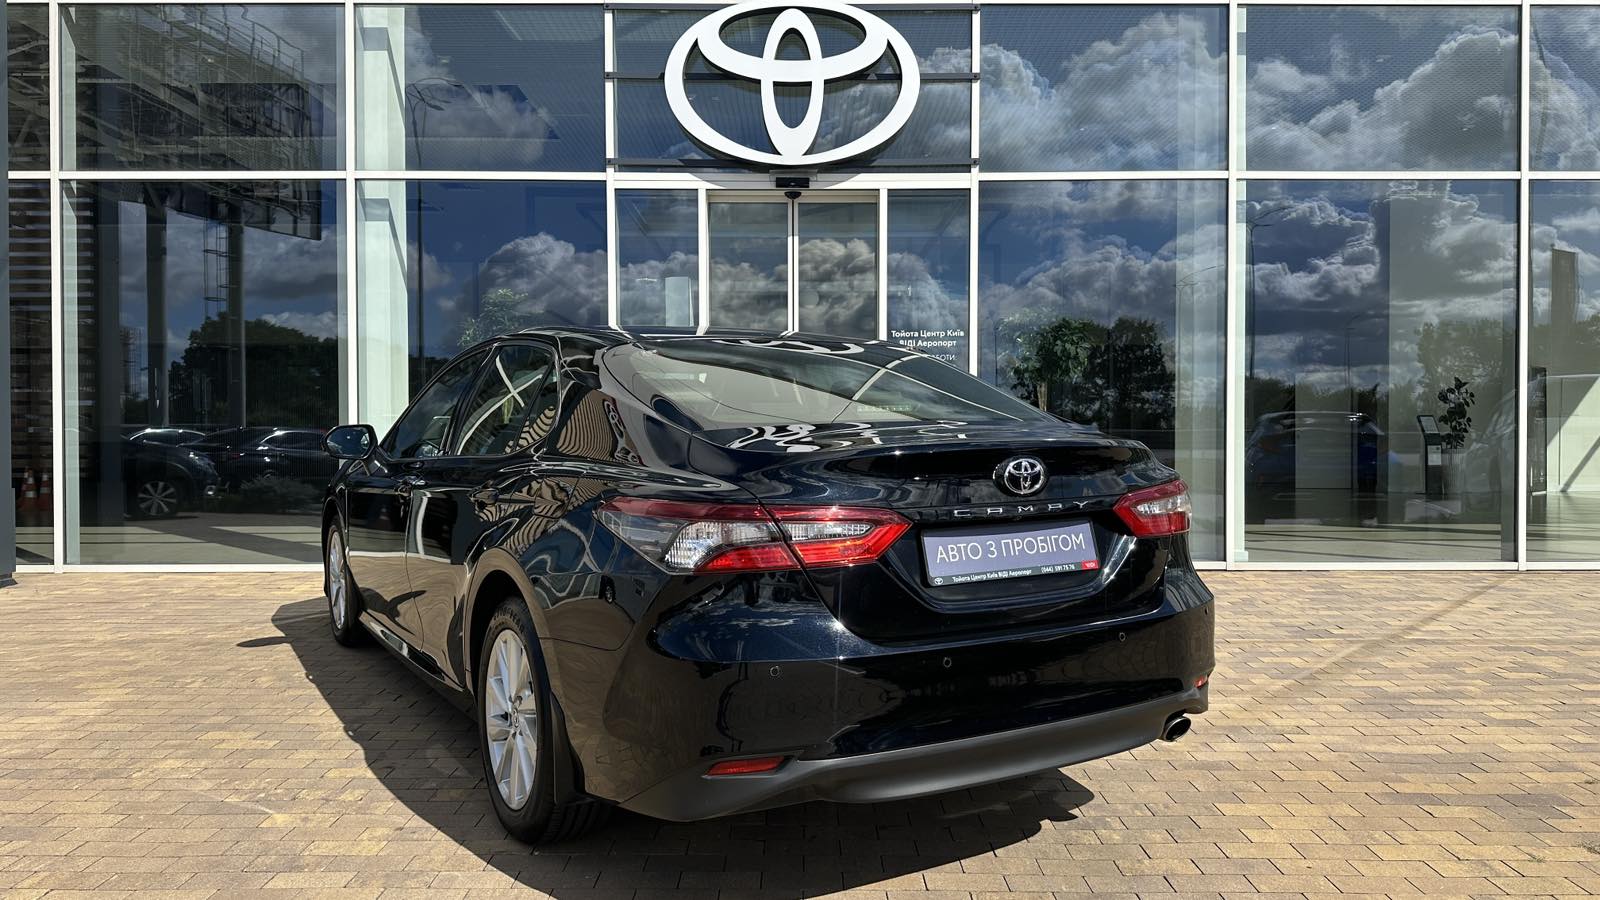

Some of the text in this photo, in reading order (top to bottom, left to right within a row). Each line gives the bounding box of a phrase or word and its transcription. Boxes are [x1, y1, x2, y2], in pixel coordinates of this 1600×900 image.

[920, 330, 945, 338] Центр
[946, 329, 964, 337] Київ
[954, 501, 1088, 517] CAMRY
[936, 542, 982, 564] АВТО
[1001, 532, 1086, 557] ПРОБІГОМ
